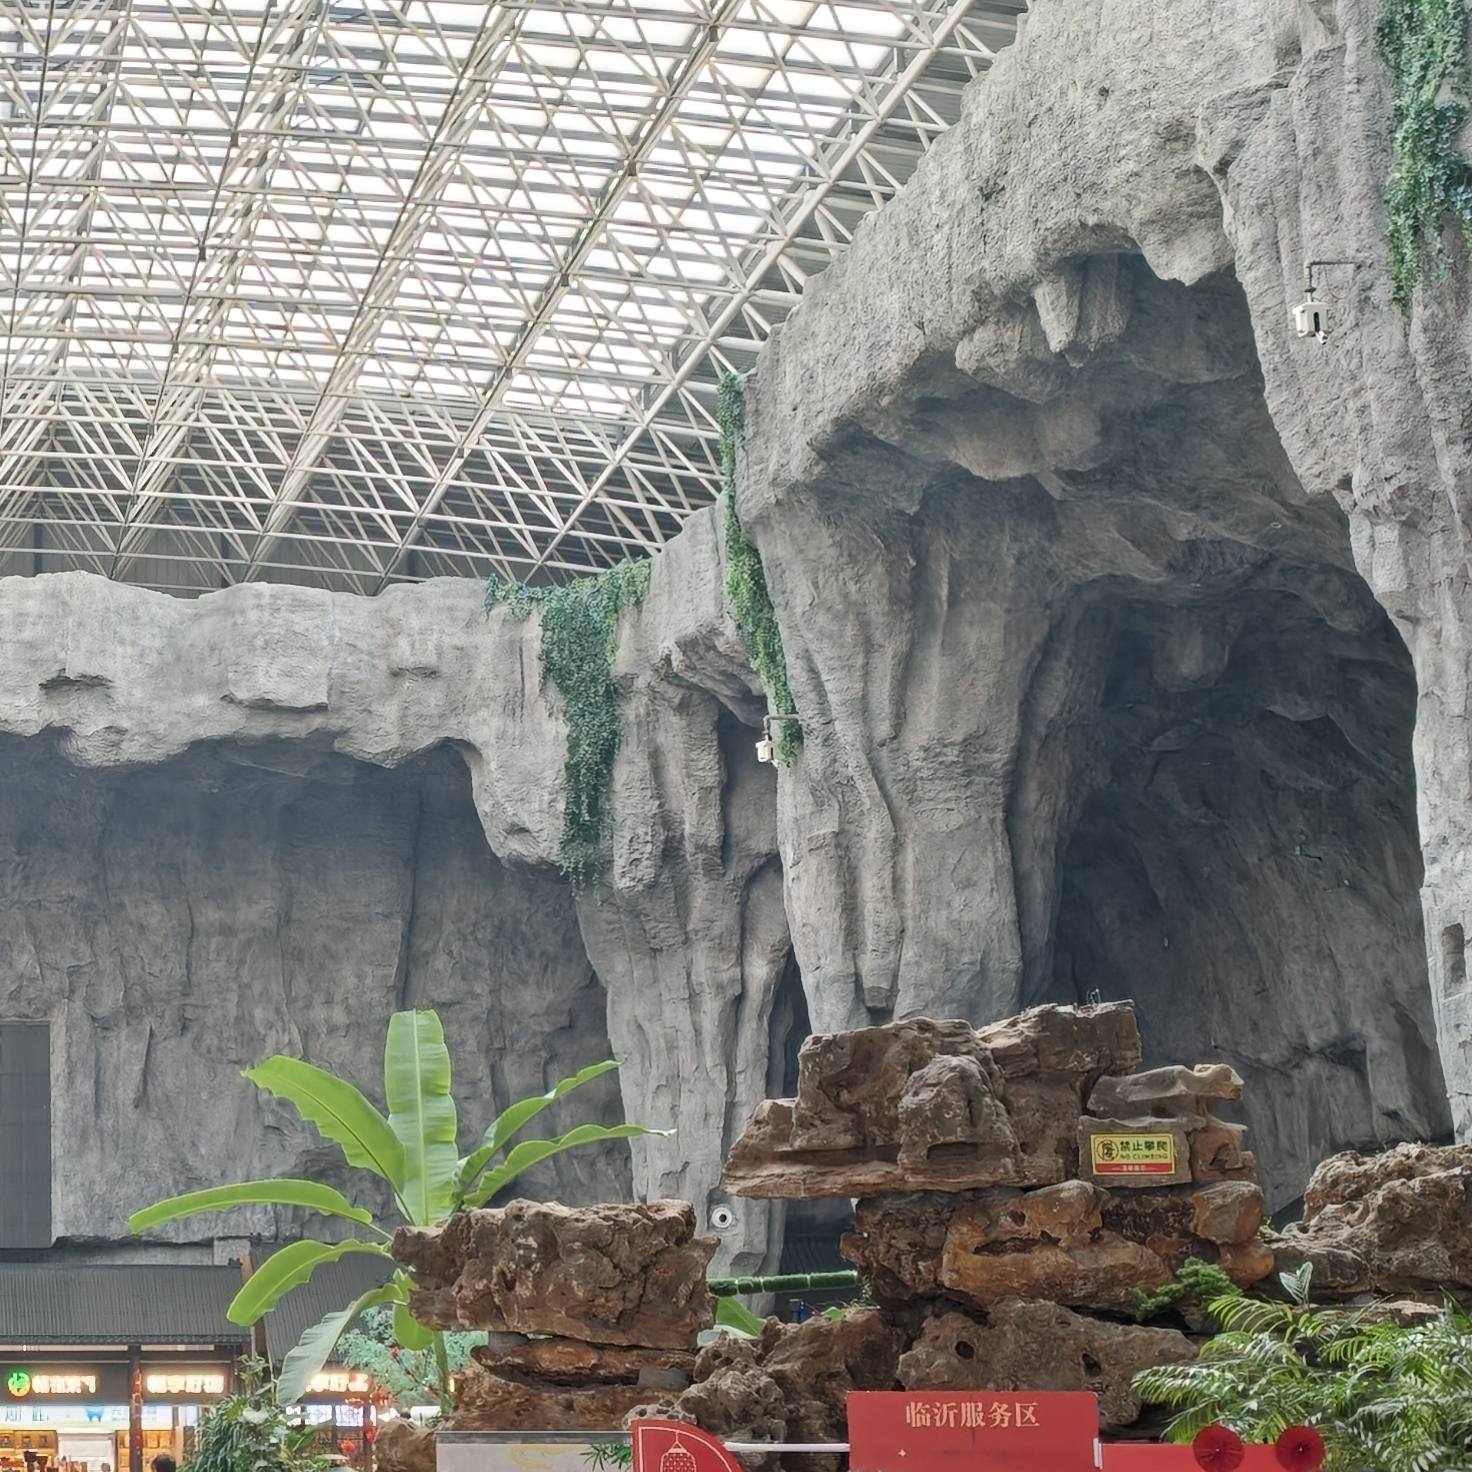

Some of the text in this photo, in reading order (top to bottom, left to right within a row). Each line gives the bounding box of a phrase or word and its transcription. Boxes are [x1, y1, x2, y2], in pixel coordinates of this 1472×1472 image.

[1120, 1140, 1168, 1152] 禁止攀爬
[906, 1401, 1040, 1428] 临沂服务区
